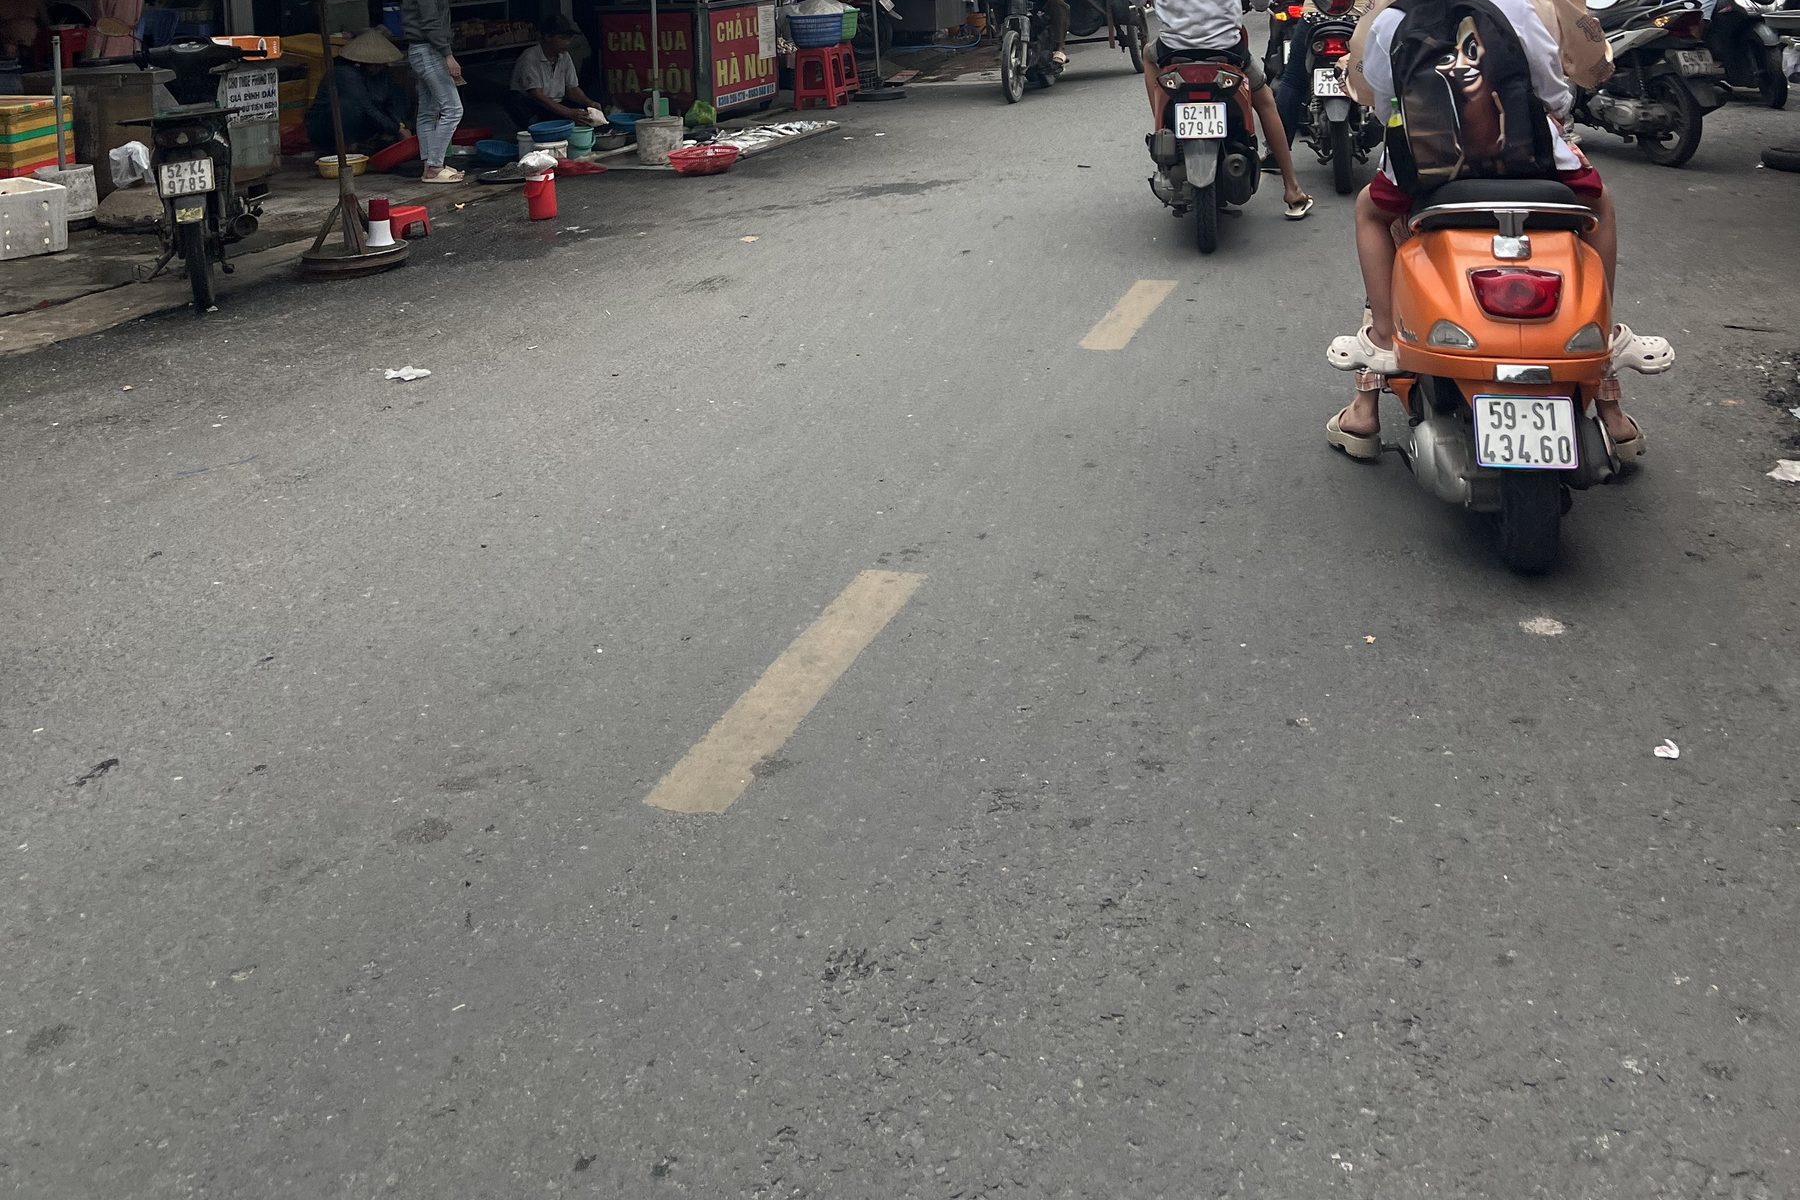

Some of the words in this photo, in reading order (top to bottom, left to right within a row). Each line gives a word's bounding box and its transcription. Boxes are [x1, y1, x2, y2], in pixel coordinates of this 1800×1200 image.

[607, 24, 647, 52] CHẢ
[653, 30, 687, 55] ỤA
[716, 12, 744, 43] CHẢ
[608, 63, 641, 97] HÀ
[716, 52, 741, 88] HÀ
[1318, 82, 1342, 94] 216.
[1179, 120, 1224, 136] 879.46
[1183, 105, 1217, 120] 62-M1
[1488, 401, 1557, 431] 59-S1
[1483, 433, 1572, 464] 434.60
